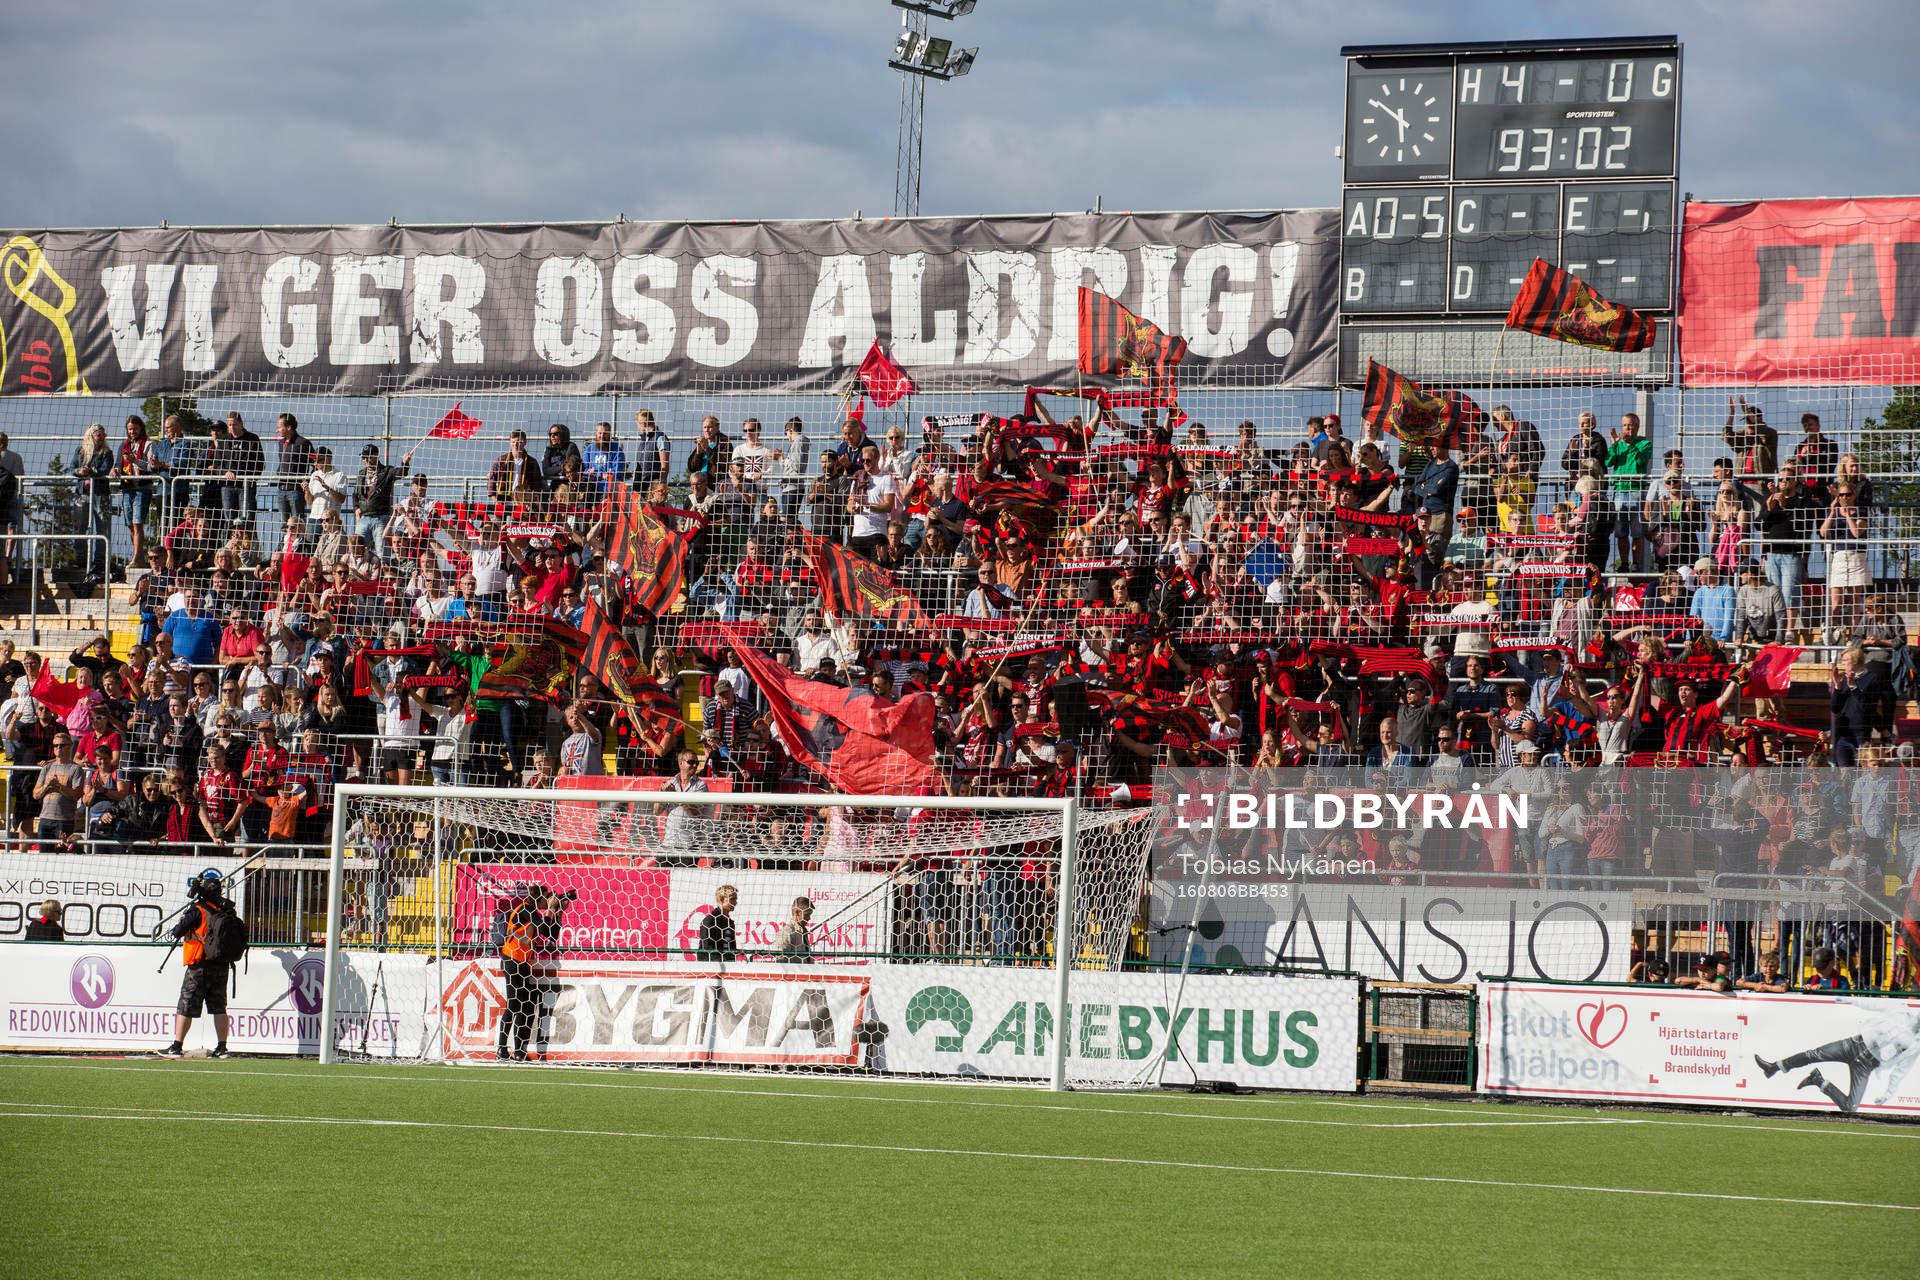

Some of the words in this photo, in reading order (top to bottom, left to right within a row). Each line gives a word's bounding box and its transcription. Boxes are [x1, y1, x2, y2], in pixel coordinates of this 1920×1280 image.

[1461, 68, 1482, 103] H
[1502, 65, 1526, 103] 4
[1607, 60, 1633, 103] 0
[1651, 62, 1673, 97] G
[1498, 126, 1632, 172] 93:02
[1347, 202, 1367, 236] A
[1457, 199, 1477, 233] C
[1566, 197, 1589, 231] E
[1345, 267, 1365, 301] B
[1453, 265, 1474, 300] D
[101, 264, 218, 371] VI
[260, 255, 487, 368] GER
[533, 254, 760, 368] OSS
[797, 242, 1301, 369] ALDRIG!
[29, 878, 164, 897] ÖSTERSUND
[1272, 890, 1610, 985] ANSJÖ
[530, 984, 837, 1049] BYGMA
[1502, 1007, 1572, 1039] akut
[976, 1000, 1320, 1069] ANEBYHUS
[1658, 1026, 1739, 1042] Hjärtstartare
[1499, 1047, 1621, 1086] hjälpen
[1664, 1061, 1732, 1077] Brandskydd
[1670, 1044, 1727, 1060] Utbildning
